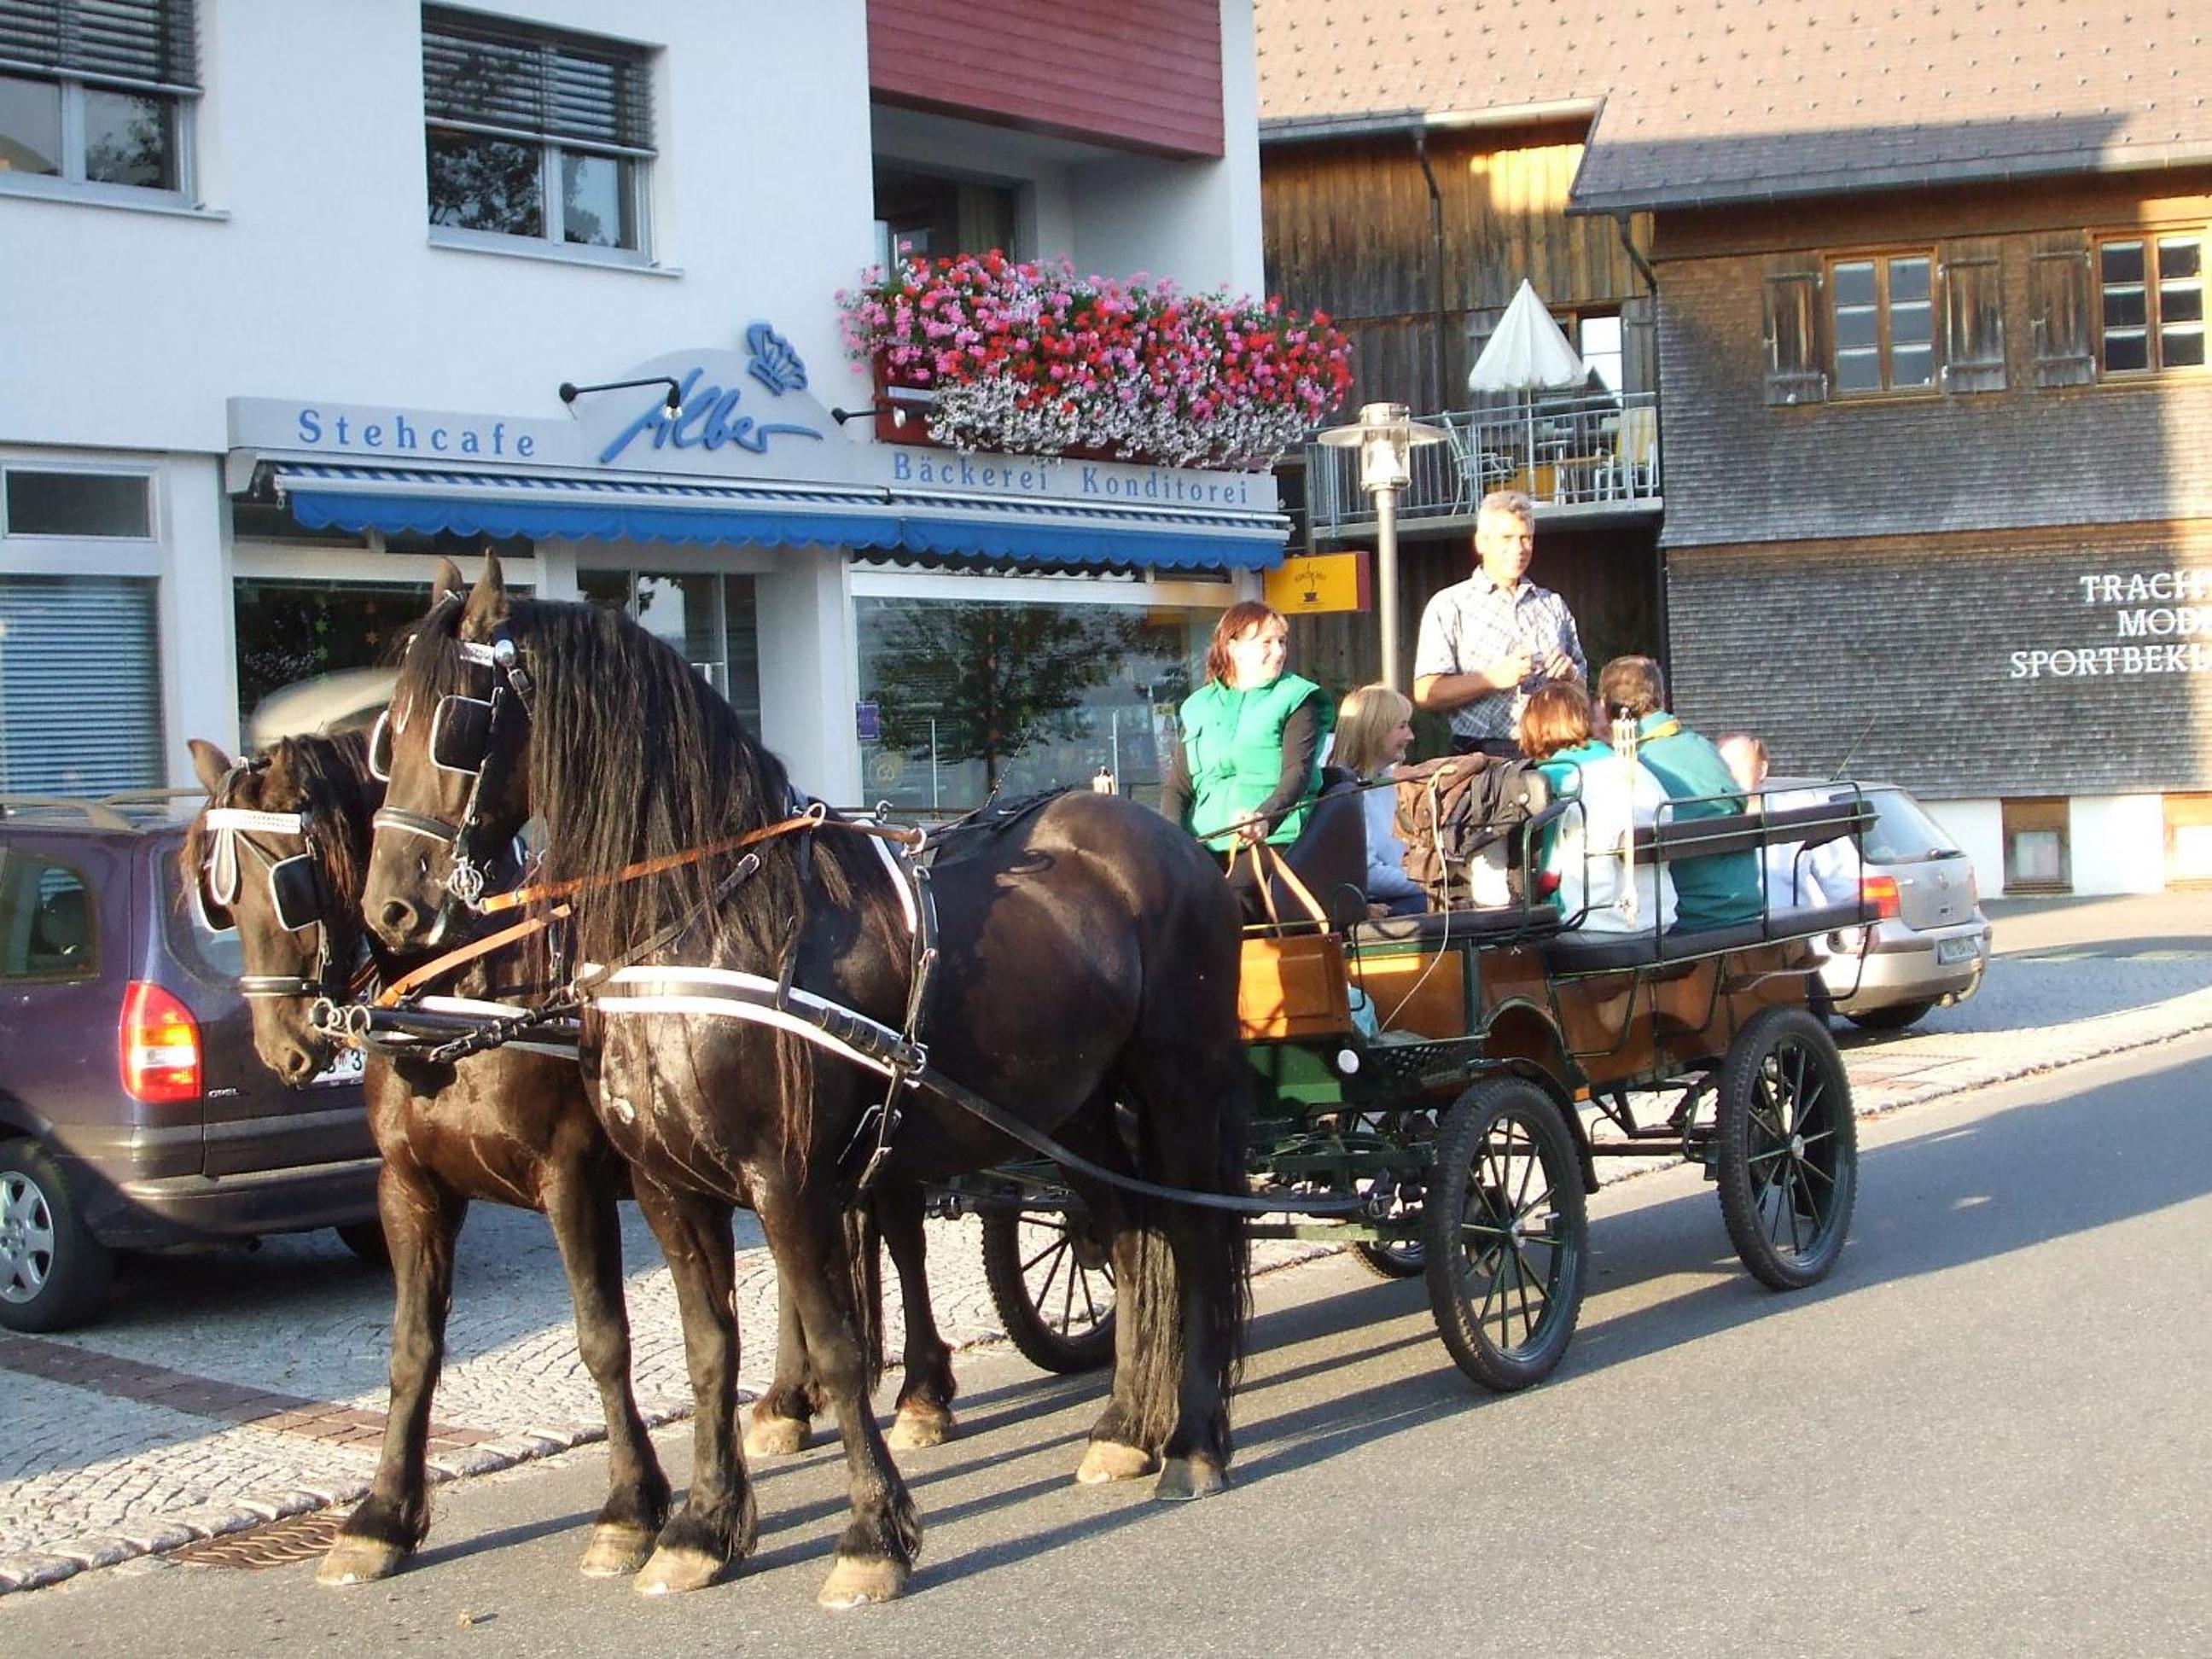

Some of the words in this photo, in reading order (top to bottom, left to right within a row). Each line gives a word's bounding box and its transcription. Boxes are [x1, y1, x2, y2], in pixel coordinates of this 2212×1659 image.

[299, 409, 534, 457] Stehcafe
[894, 451, 1046, 491] Bäckerei
[1082, 466, 1248, 504] Konditorei
